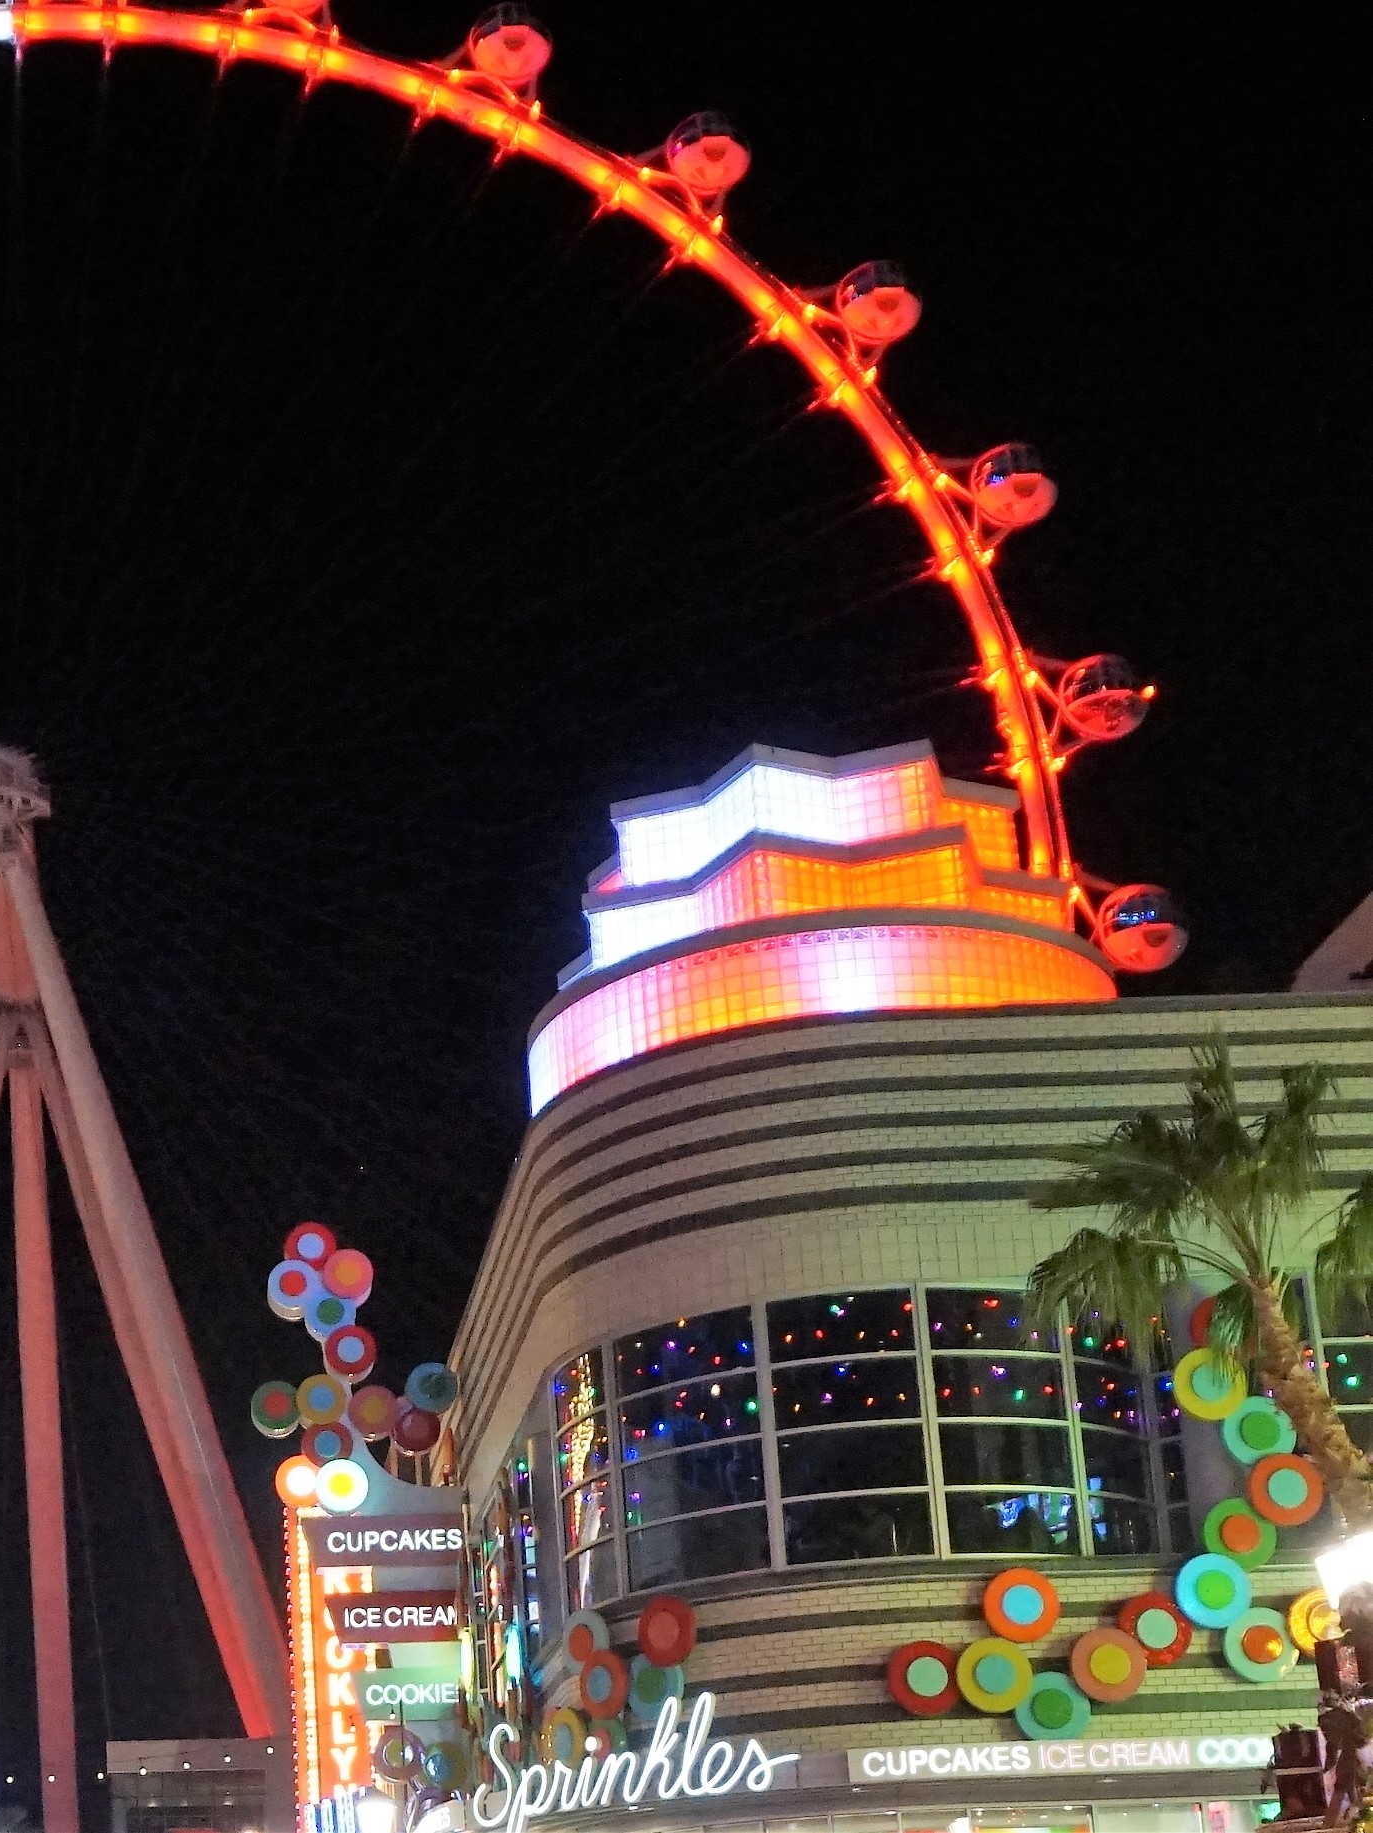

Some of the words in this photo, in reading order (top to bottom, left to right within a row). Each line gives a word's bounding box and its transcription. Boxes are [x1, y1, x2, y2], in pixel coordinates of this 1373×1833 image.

[327, 1528, 463, 1553] CUPCAKES
[344, 1608, 382, 1628] ICE
[365, 1683, 459, 1705] COOKIE
[473, 1691, 800, 1833] Sprinkles
[863, 1745, 1031, 1778] CUPCAKES
[1039, 1743, 1087, 1769] ICE
[1089, 1740, 1190, 1768] CREAM
